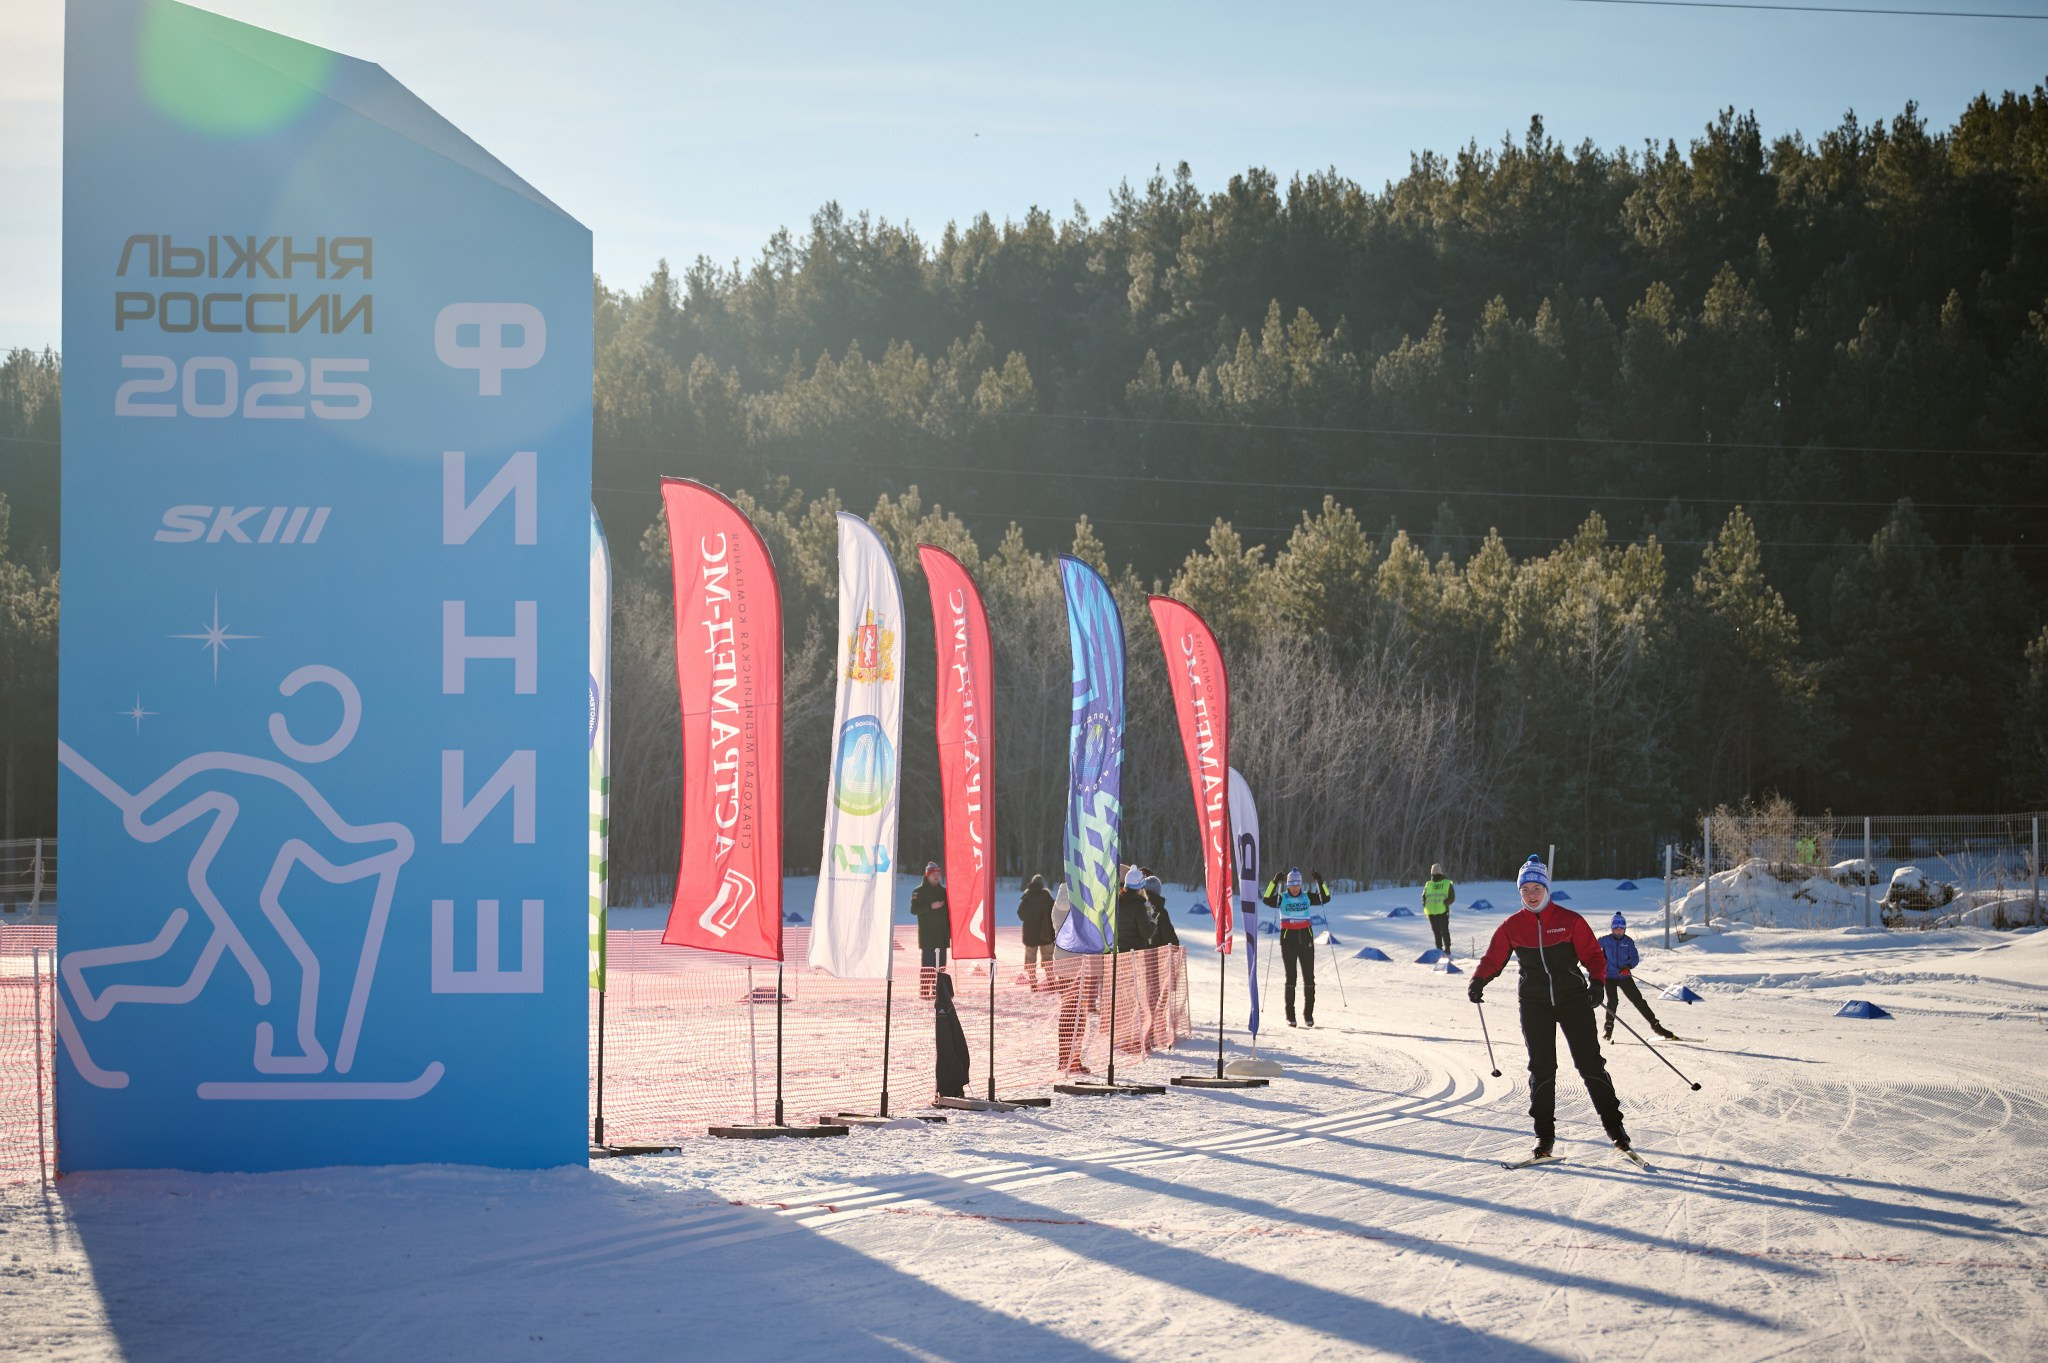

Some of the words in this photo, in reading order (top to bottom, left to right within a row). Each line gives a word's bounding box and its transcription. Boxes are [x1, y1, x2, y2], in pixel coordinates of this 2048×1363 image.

[115, 234, 372, 280] ЛЫЖНЯ
[115, 291, 372, 334] РОССИИ
[115, 354, 372, 420] 2025
[431, 302, 547, 994] ФИНИШ
